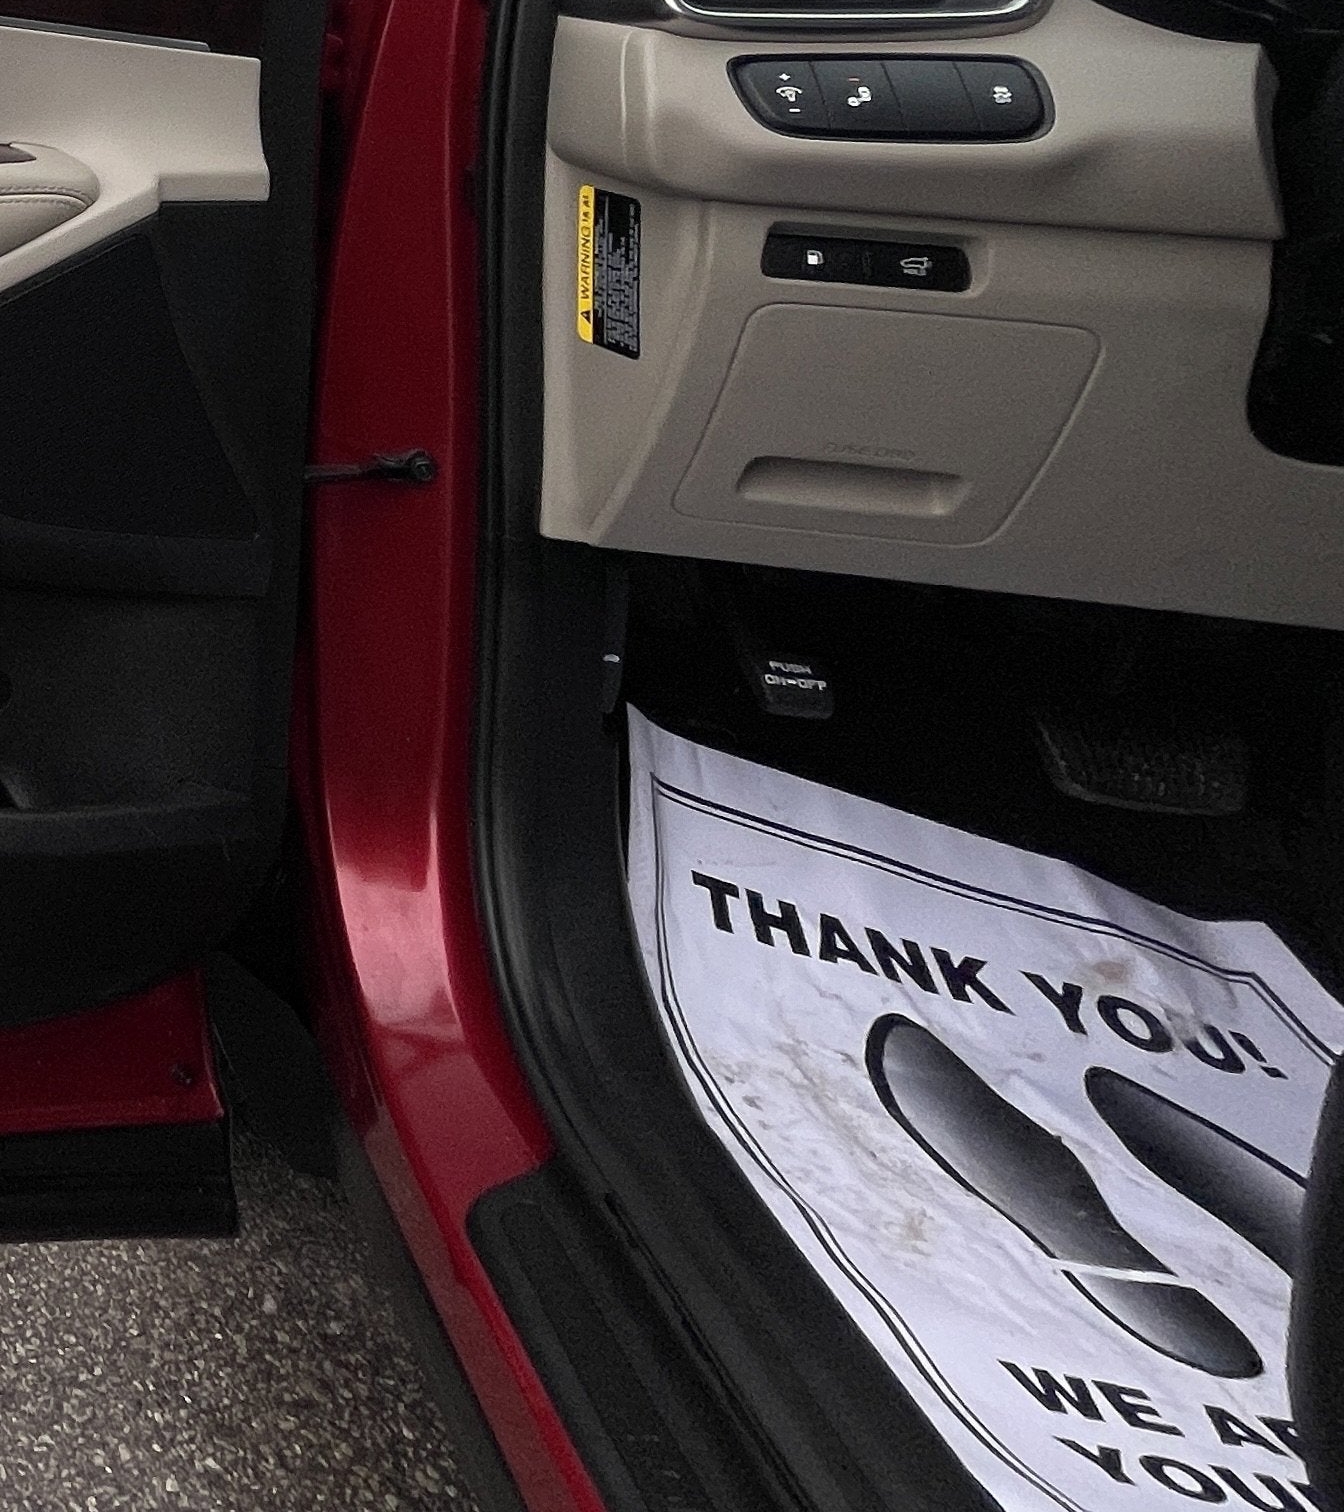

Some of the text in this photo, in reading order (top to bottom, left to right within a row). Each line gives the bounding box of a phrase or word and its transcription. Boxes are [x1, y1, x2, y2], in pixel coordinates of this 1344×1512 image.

[580, 224, 590, 300] WARNING
[691, 870, 1289, 1080] THANK YOU!
[997, 1358, 1185, 1437] WE
[1053, 1436, 1324, 1512] YOU
